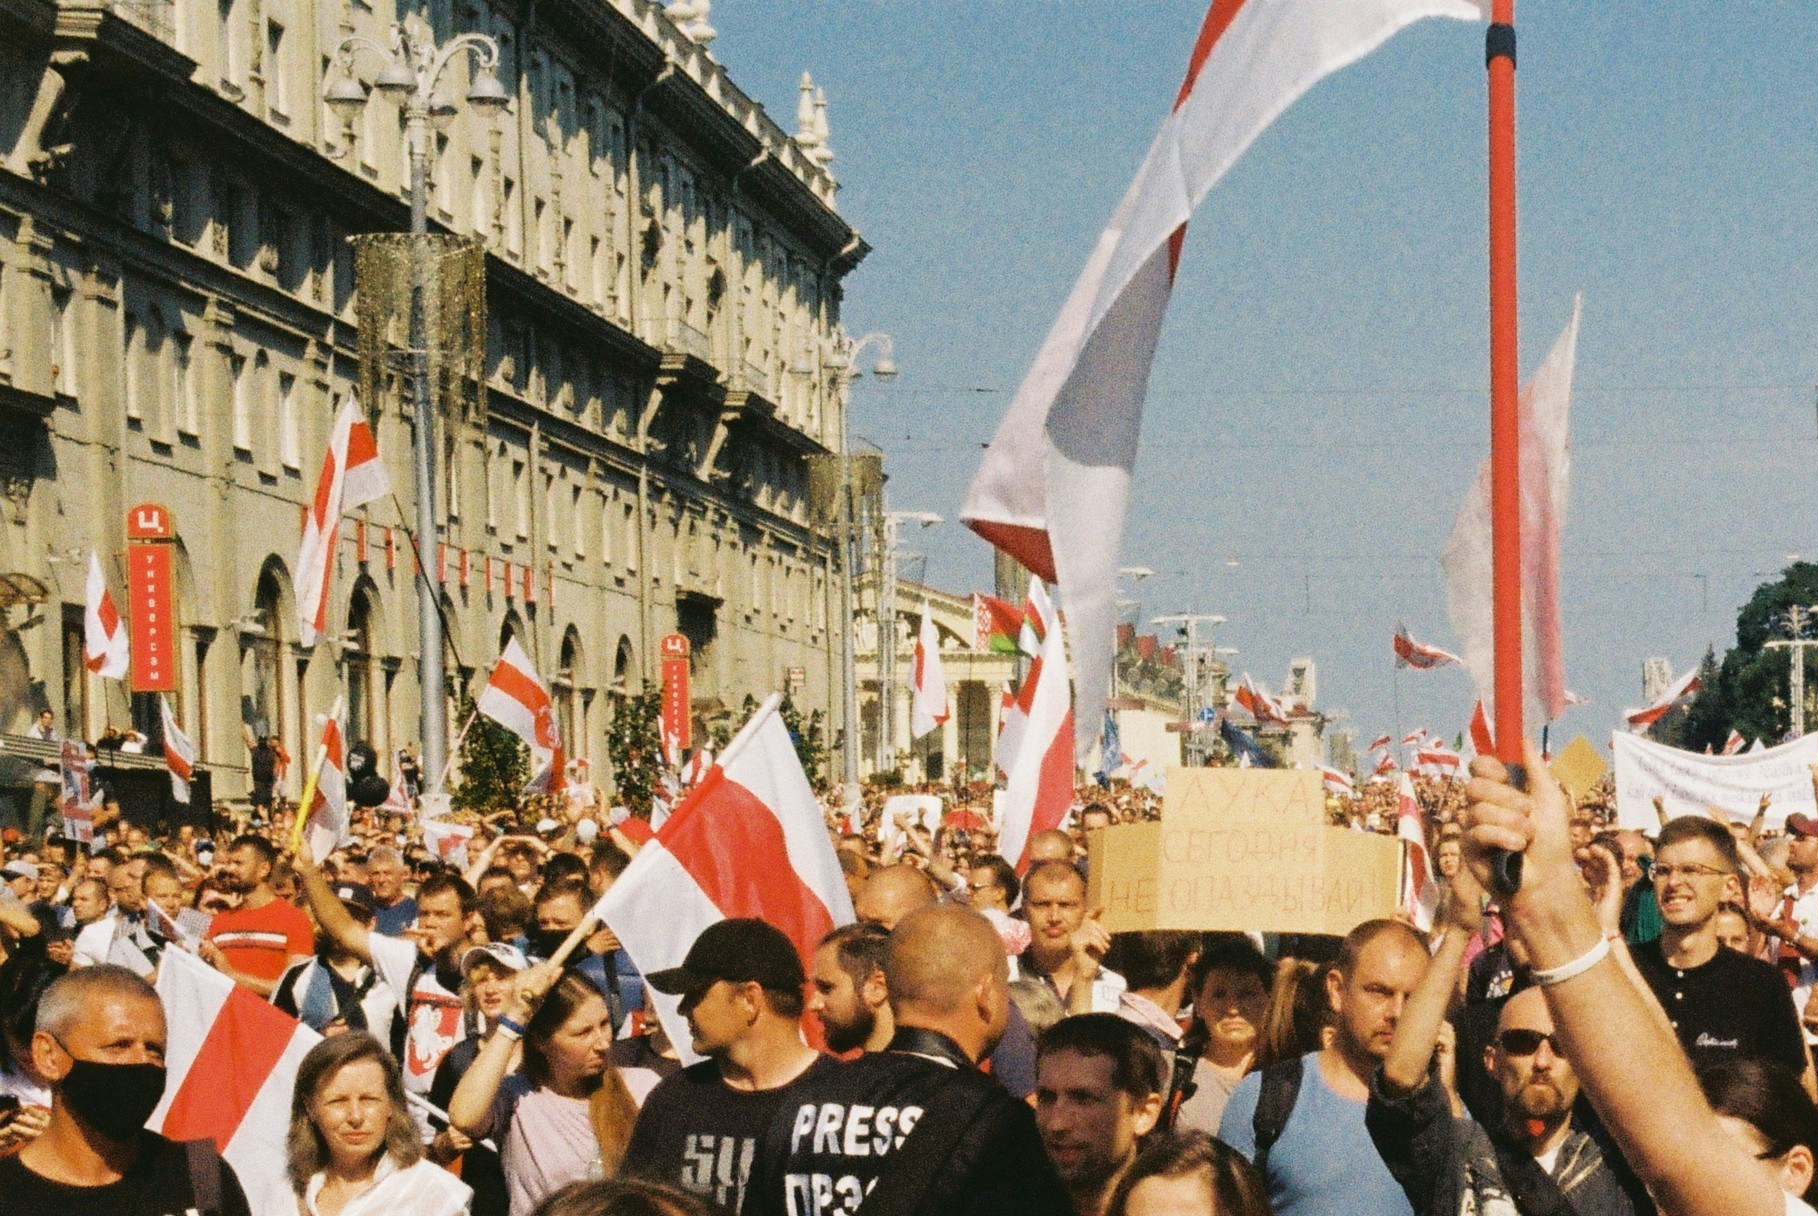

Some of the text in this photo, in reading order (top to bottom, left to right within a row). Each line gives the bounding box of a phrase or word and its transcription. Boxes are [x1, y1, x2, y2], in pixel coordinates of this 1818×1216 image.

[1164, 829, 1318, 864] СЕГОДНЯ
[1107, 878, 1154, 914] НЕ
[791, 1103, 924, 1156] PRESS
